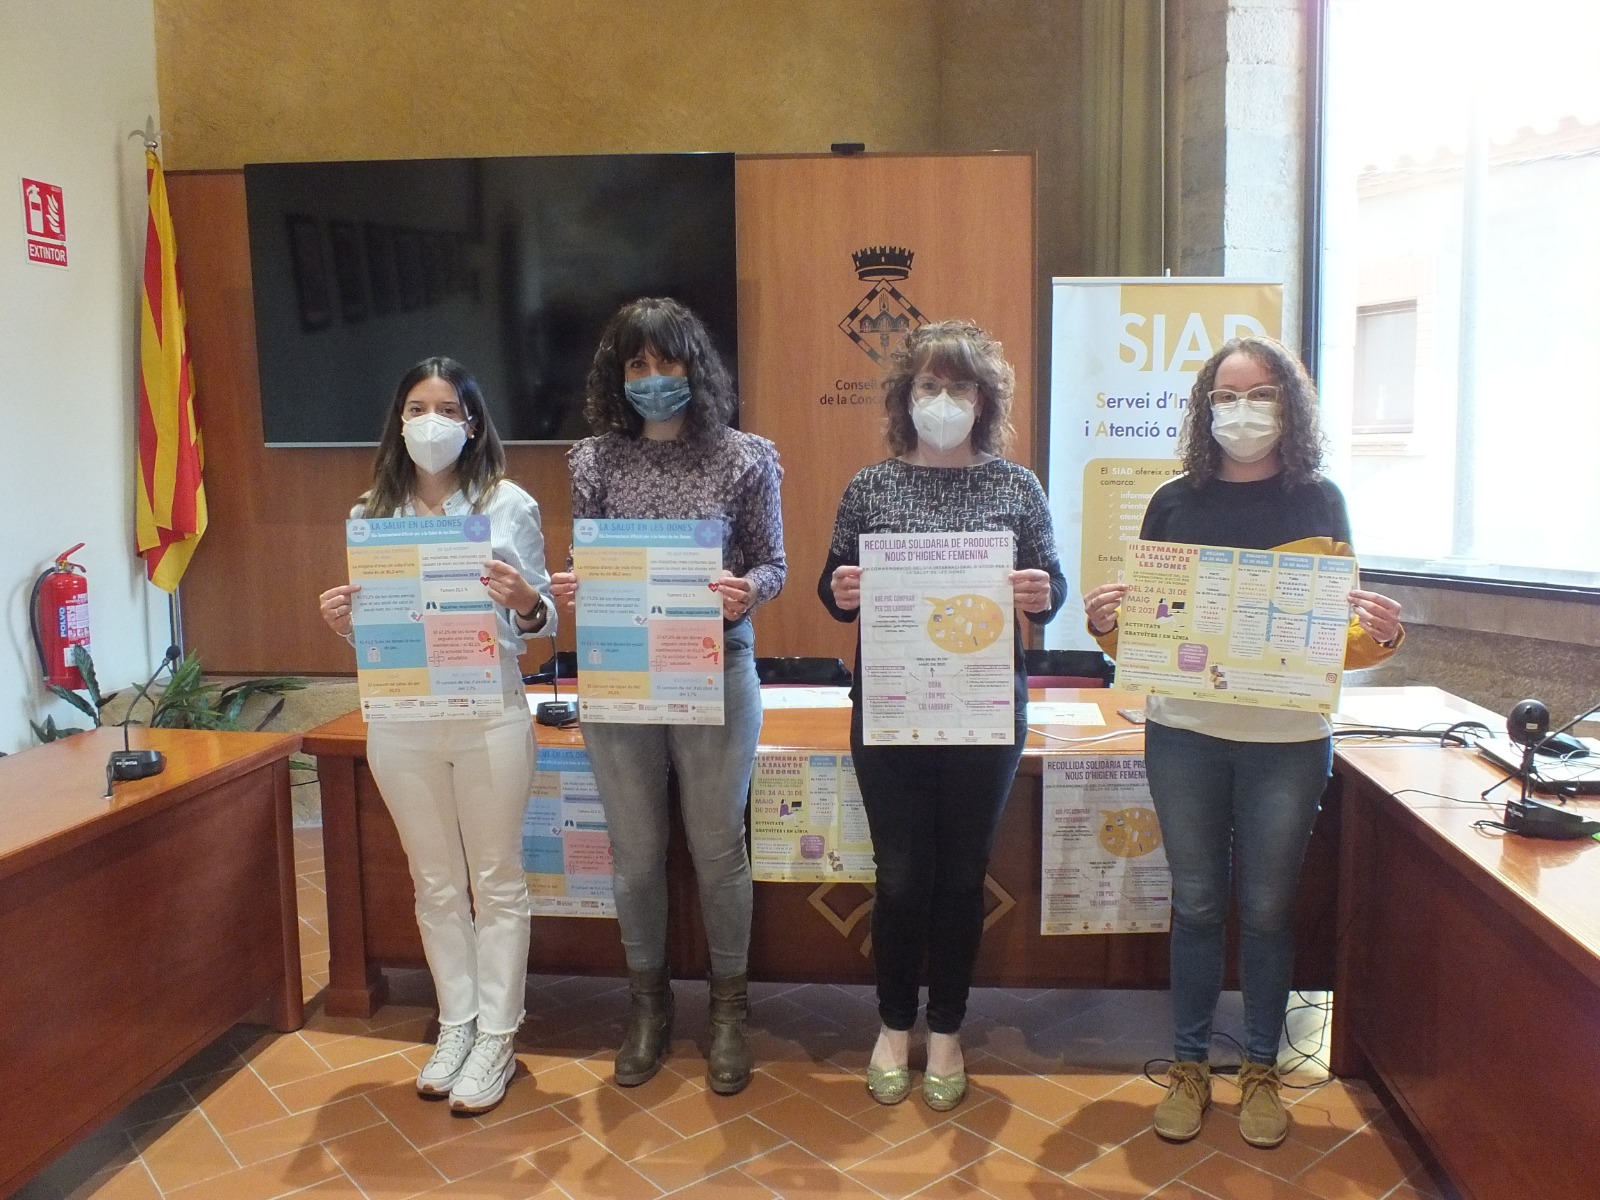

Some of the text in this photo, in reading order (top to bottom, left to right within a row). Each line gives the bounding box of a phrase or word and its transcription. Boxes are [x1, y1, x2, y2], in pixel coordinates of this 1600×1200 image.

[29, 244, 66, 262] EXTINTOR
[836, 380, 877, 390] Consell
[820, 394, 834, 405] de
[838, 394, 847, 405] la
[1096, 392, 1150, 409] Servei
[1085, 420, 1177, 438] i Atenció a
[1136, 468, 1162, 476] ofereix
[1120, 490, 1151, 499] informa
[1120, 512, 1142, 520] atenci
[371, 518, 462, 531] LA SALUT EN LES DONES
[600, 523, 693, 532] LA SALUT EN LES DONES
[864, 537, 1009, 550] RECOLLIDA SOLIDÀRIA DE PRODUCTES
[1141, 545, 1184, 554] SETMANA
[885, 550, 989, 562] NOUS D'HIGIENE FEMENINA
[1048, 762, 1084, 770] RECOLLIDA
[1086, 760, 1122, 769] SOLIDÀRIA
[1123, 761, 1131, 769] DE
[1065, 772, 1084, 780] NOUS
[1085, 771, 1118, 780] D'HIGIENE
